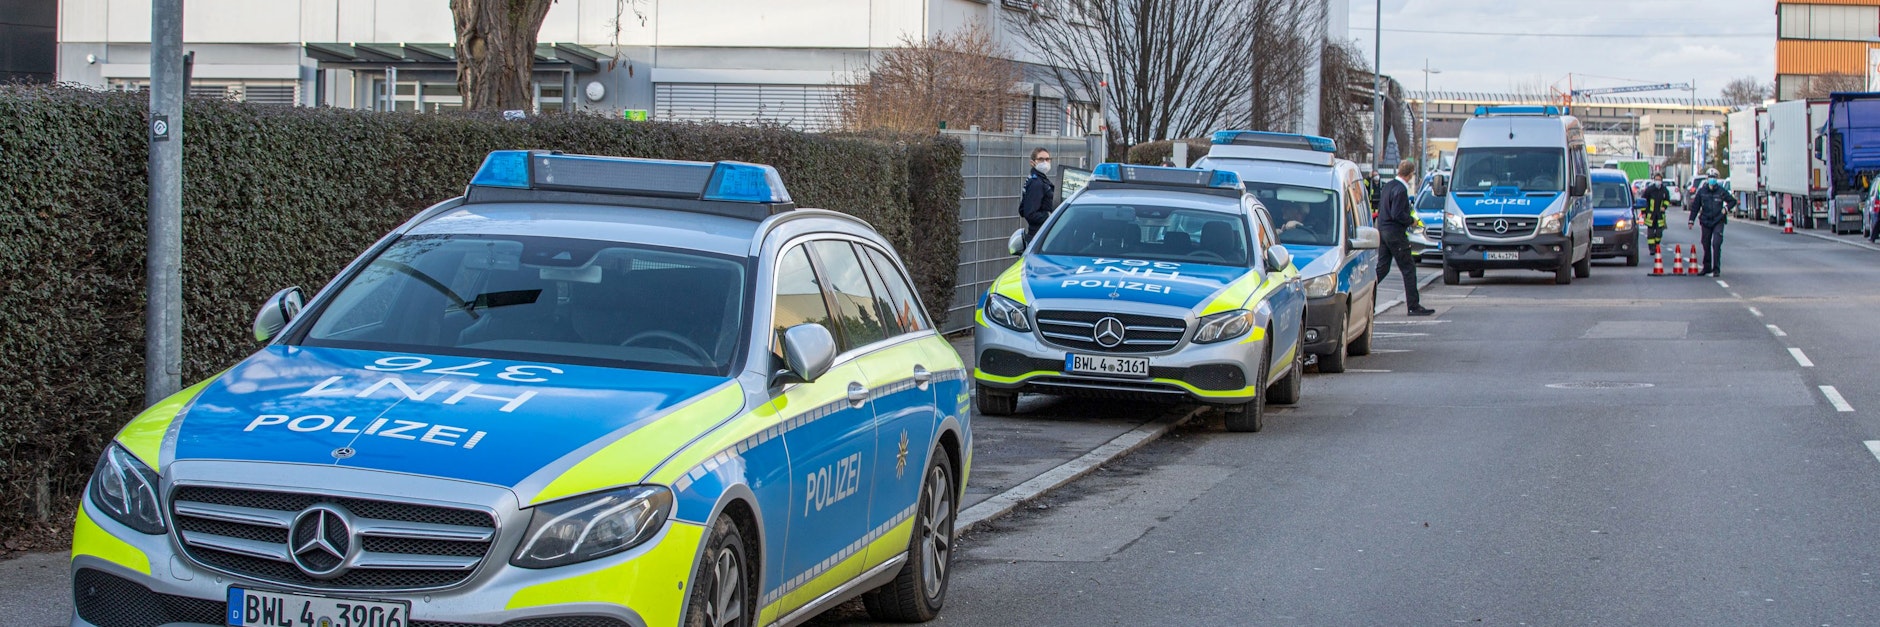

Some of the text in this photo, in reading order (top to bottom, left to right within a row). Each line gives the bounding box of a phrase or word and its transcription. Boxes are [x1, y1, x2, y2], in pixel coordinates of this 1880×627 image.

[1092, 257, 1181, 270] 364
[1061, 280, 1171, 295] POLIZEI
[364, 356, 564, 383] 376
[1074, 356, 1097, 371] BWL
[1100, 358, 1107, 372] 4
[1116, 359, 1147, 374] 3161
[300, 375, 539, 413] HN1
[243, 414, 488, 450] POLIZEI
[804, 451, 862, 518] POLIZEI
[232, 594, 401, 627] D BWL 4 3906
